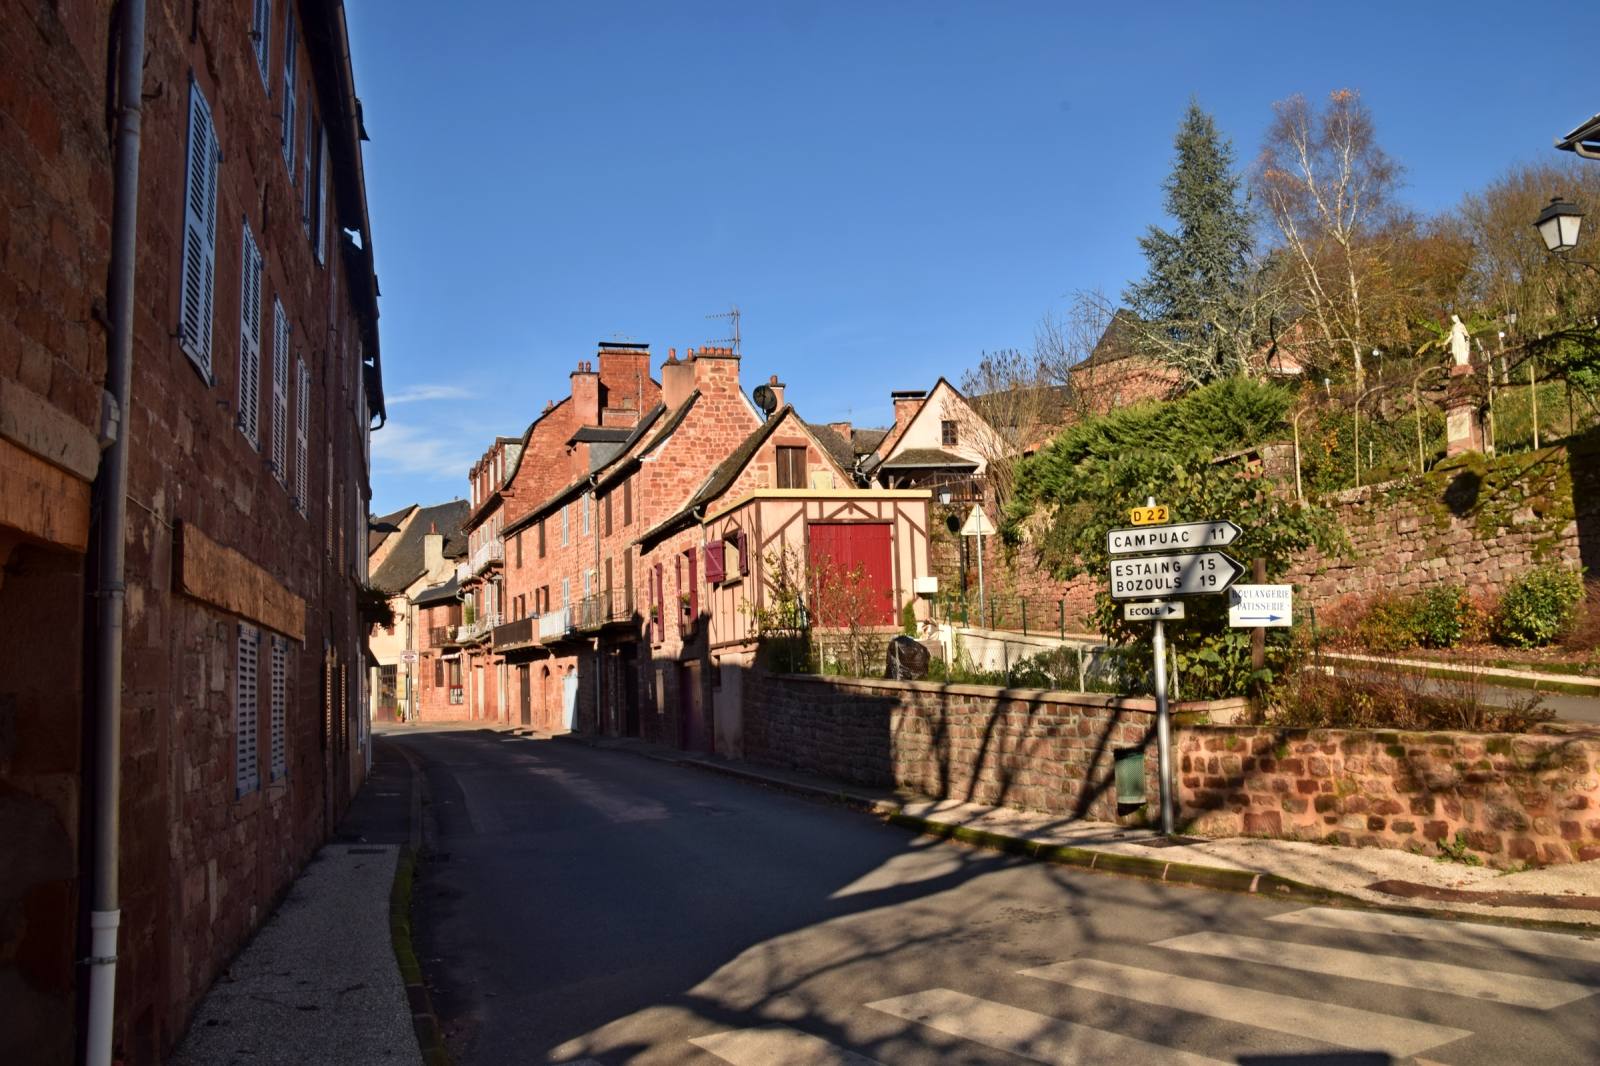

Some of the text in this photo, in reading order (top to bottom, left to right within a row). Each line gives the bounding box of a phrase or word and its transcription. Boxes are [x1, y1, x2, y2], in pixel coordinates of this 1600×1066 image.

[1133, 508, 1166, 522] D 22
[1114, 527, 1225, 548] CAMPUAC 11
[1115, 558, 1216, 577] ESTAING 15
[1116, 574, 1217, 592] BOZOULS 19
[1129, 607, 1161, 616] ECOLE
